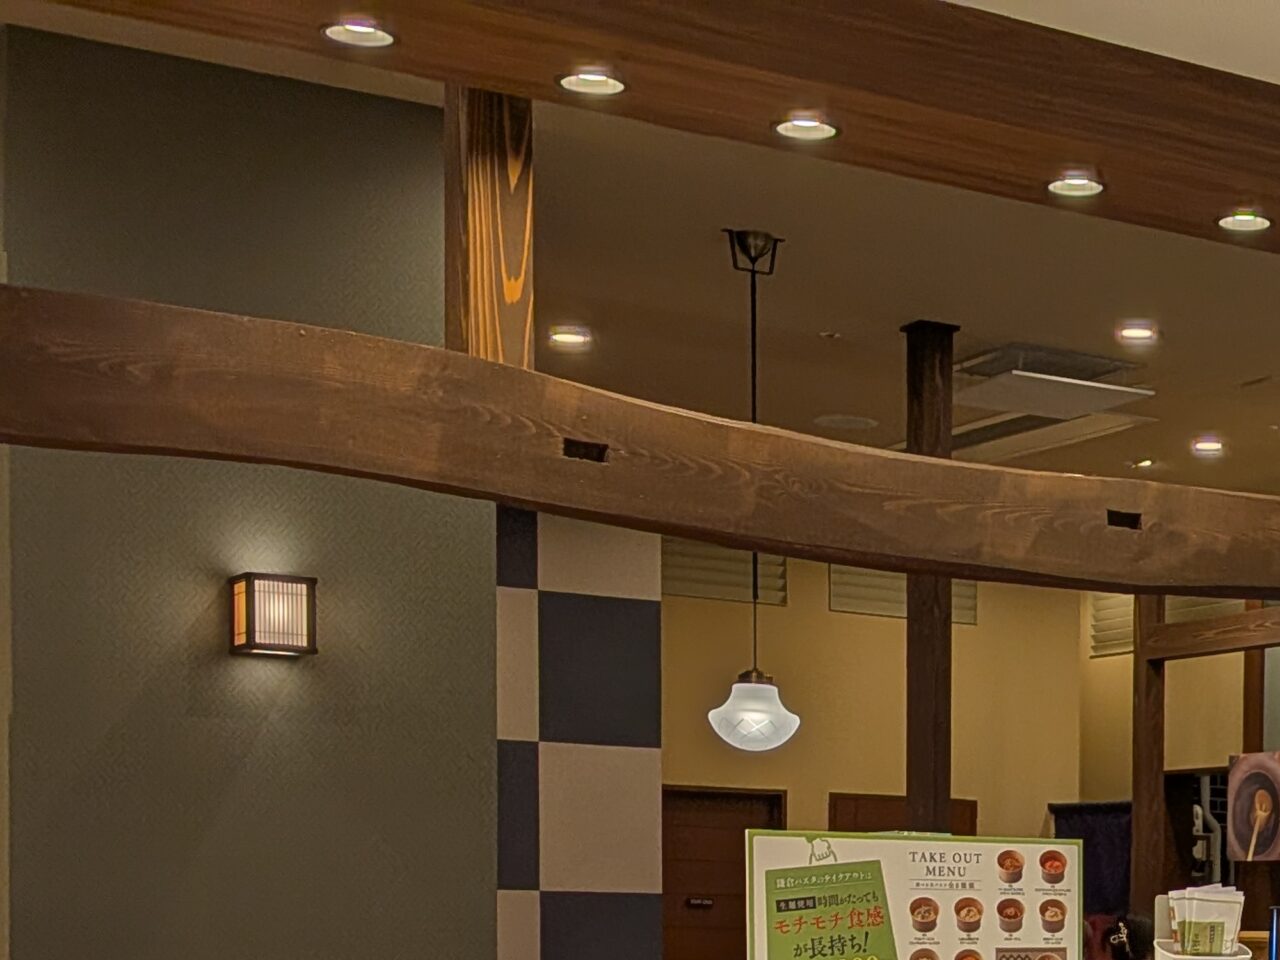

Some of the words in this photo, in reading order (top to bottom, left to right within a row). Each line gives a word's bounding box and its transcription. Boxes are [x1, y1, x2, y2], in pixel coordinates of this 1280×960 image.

[909, 851, 947, 863] TAKE
[952, 853, 982, 864] OUT
[925, 865, 967, 877] MENU
[774, 905, 885, 934] モチモチ食感
